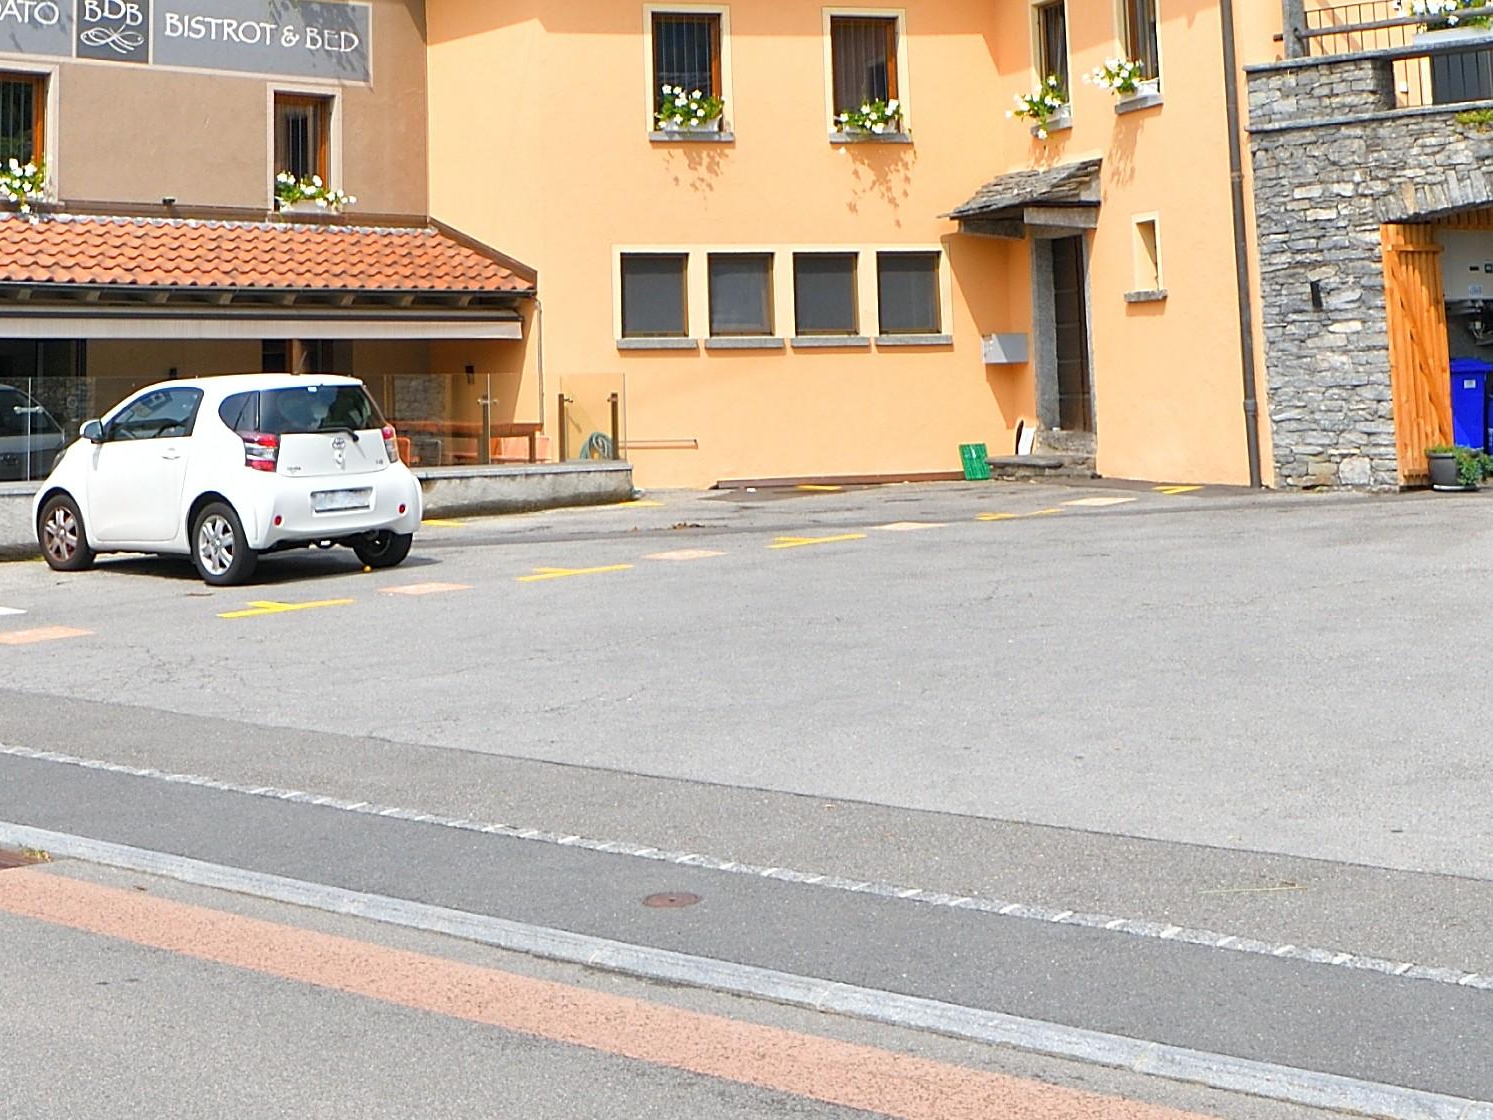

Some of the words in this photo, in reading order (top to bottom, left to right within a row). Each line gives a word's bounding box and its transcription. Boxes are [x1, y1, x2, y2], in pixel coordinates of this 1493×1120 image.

[165, 12, 277, 46] BISTROT
[281, 25, 300, 47] &
[305, 27, 359, 52] BED
